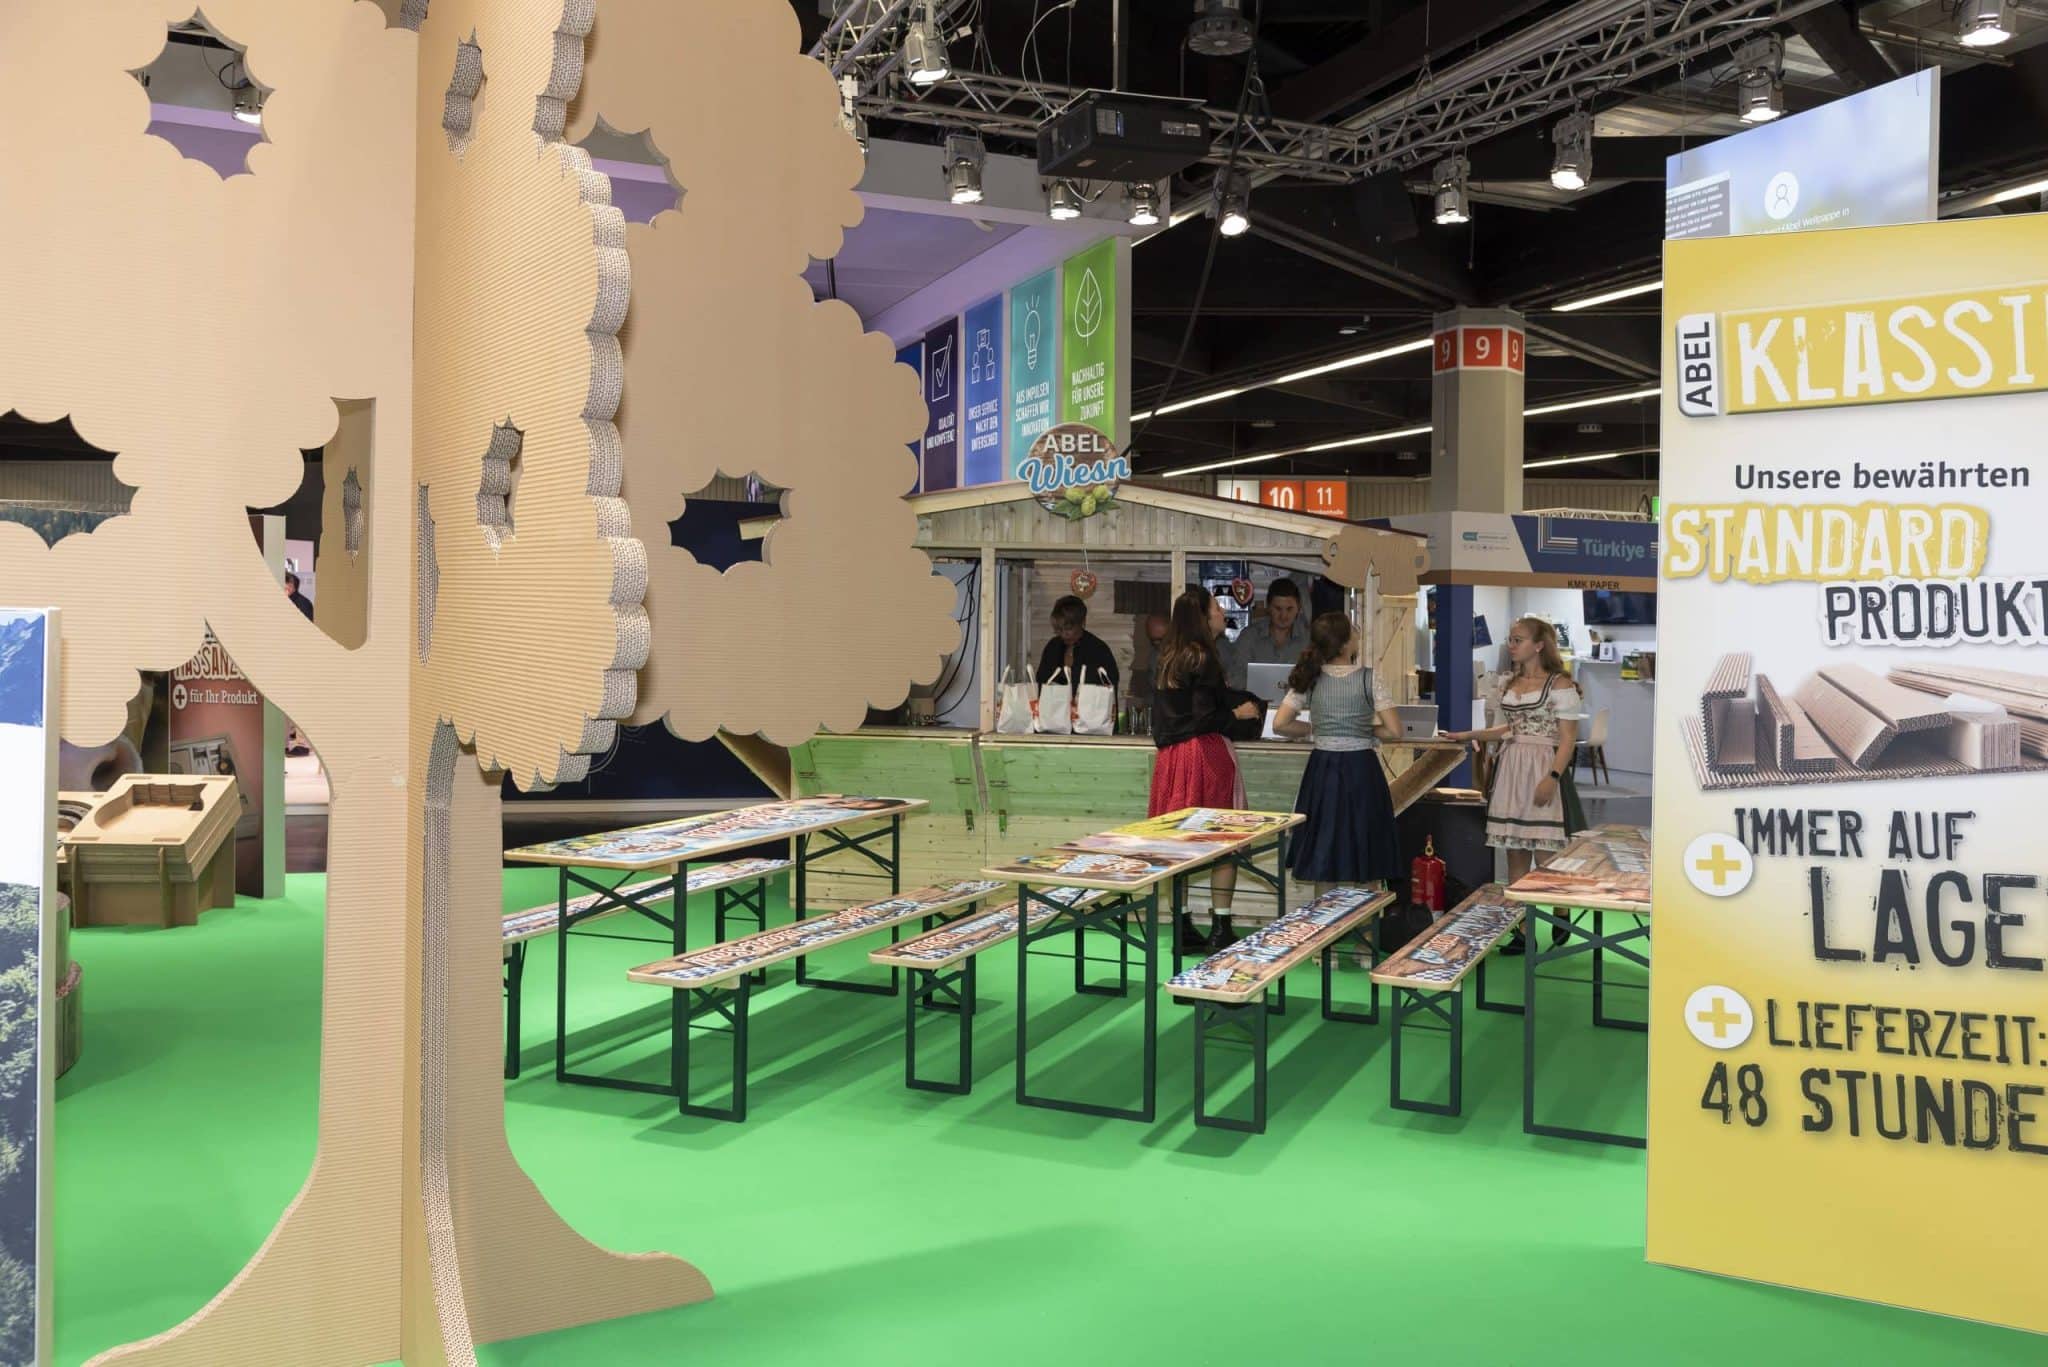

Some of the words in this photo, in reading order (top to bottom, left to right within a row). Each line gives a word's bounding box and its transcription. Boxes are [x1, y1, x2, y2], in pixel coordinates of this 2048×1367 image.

[1442, 339, 1451, 365] 9
[1476, 336, 1490, 360] 9
[1511, 339, 1519, 362] 9
[1737, 293, 2048, 405] KLASSI
[1071, 361, 1104, 386] NACHHALTIG
[1683, 320, 1713, 408] ABEL
[1016, 389, 1025, 405] AUS
[1025, 381, 1049, 401] IMPULSEN
[1071, 386, 1082, 405] FÜR
[1083, 380, 1104, 401] UNSERE
[1015, 402, 1039, 422] SCHAFFEN
[1080, 399, 1104, 421] ZUKUNFT
[1042, 433, 1105, 453] ABEL
[1018, 456, 1130, 493] Wiesn
[1734, 464, 1841, 490] Unsere
[1853, 461, 2030, 489] bewährten
[1269, 486, 1294, 510] 10
[1316, 487, 1333, 505] 11
[1582, 538, 1645, 562] Türkiye
[1670, 508, 1979, 577] STANDARD
[1567, 580, 1587, 589] KMK
[1589, 580, 1620, 590] PAPER
[190, 688, 204, 703] für
[206, 689, 219, 703] Ihr
[221, 689, 258, 705] Produkt
[1734, 808, 1863, 857] IMMER
[1888, 811, 1976, 860] AUF
[1767, 999, 2047, 1067] LIEFERZEIT:
[1701, 1061, 1768, 1127] 48
